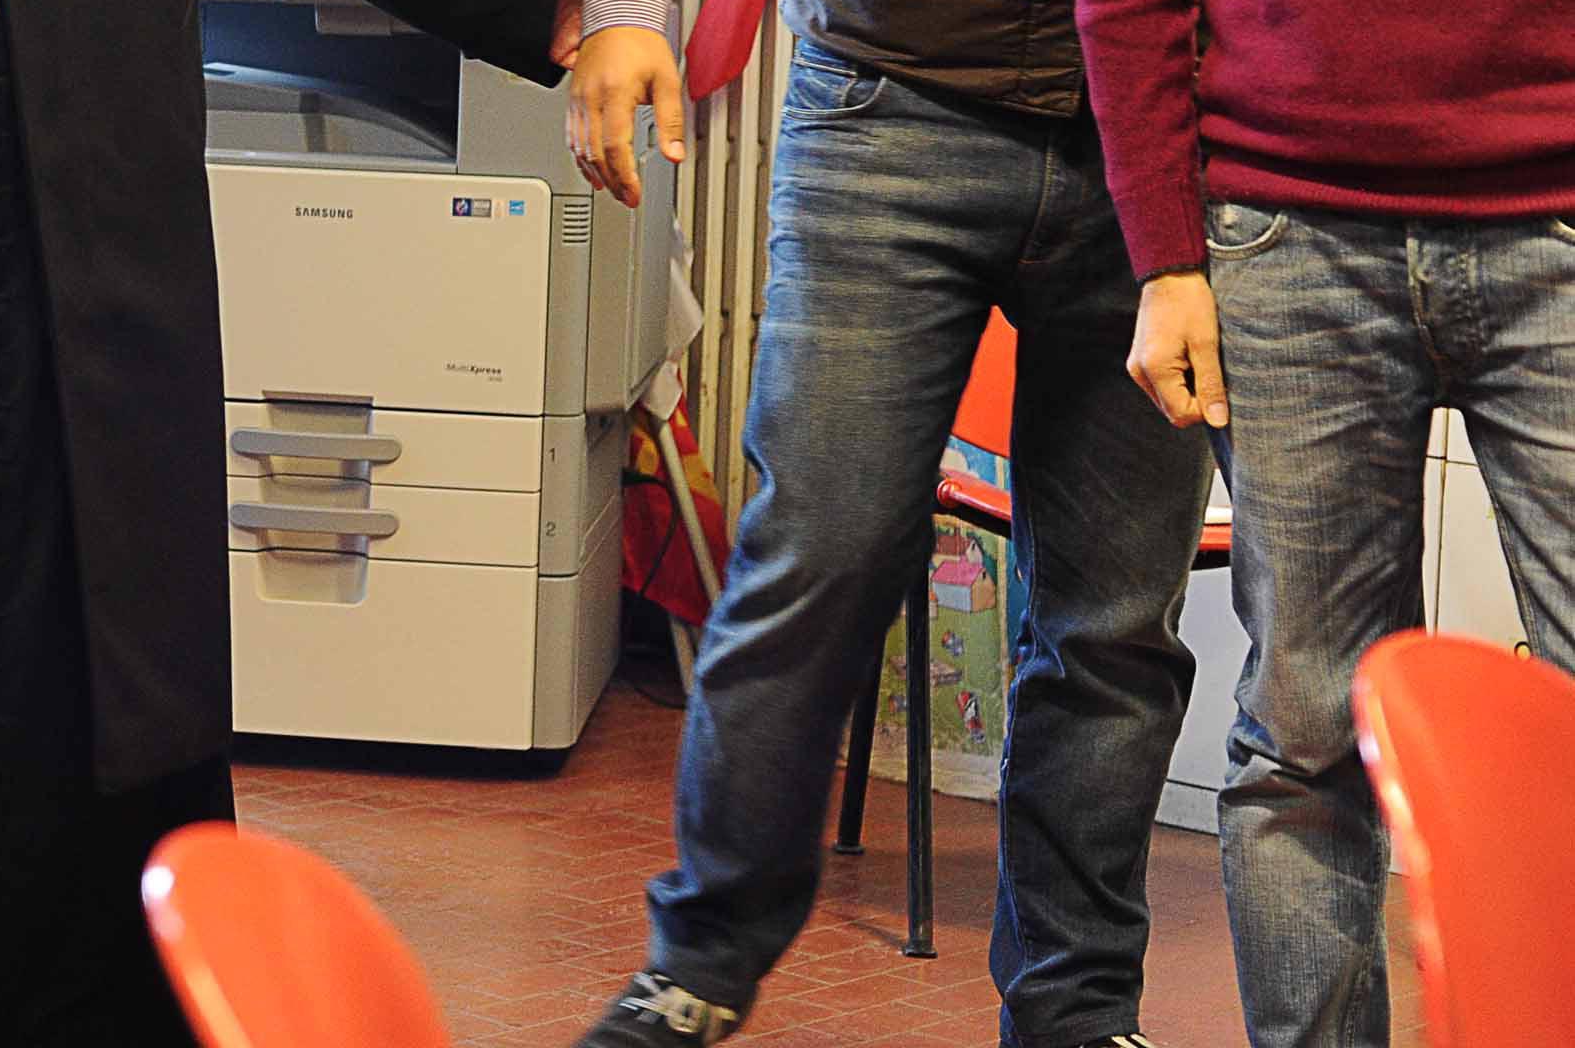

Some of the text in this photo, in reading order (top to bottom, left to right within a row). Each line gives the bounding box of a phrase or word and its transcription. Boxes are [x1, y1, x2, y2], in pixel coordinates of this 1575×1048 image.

[295, 207, 354, 219] SAMSUNG
[548, 447, 555, 462] 1
[546, 521, 556, 536] 2
